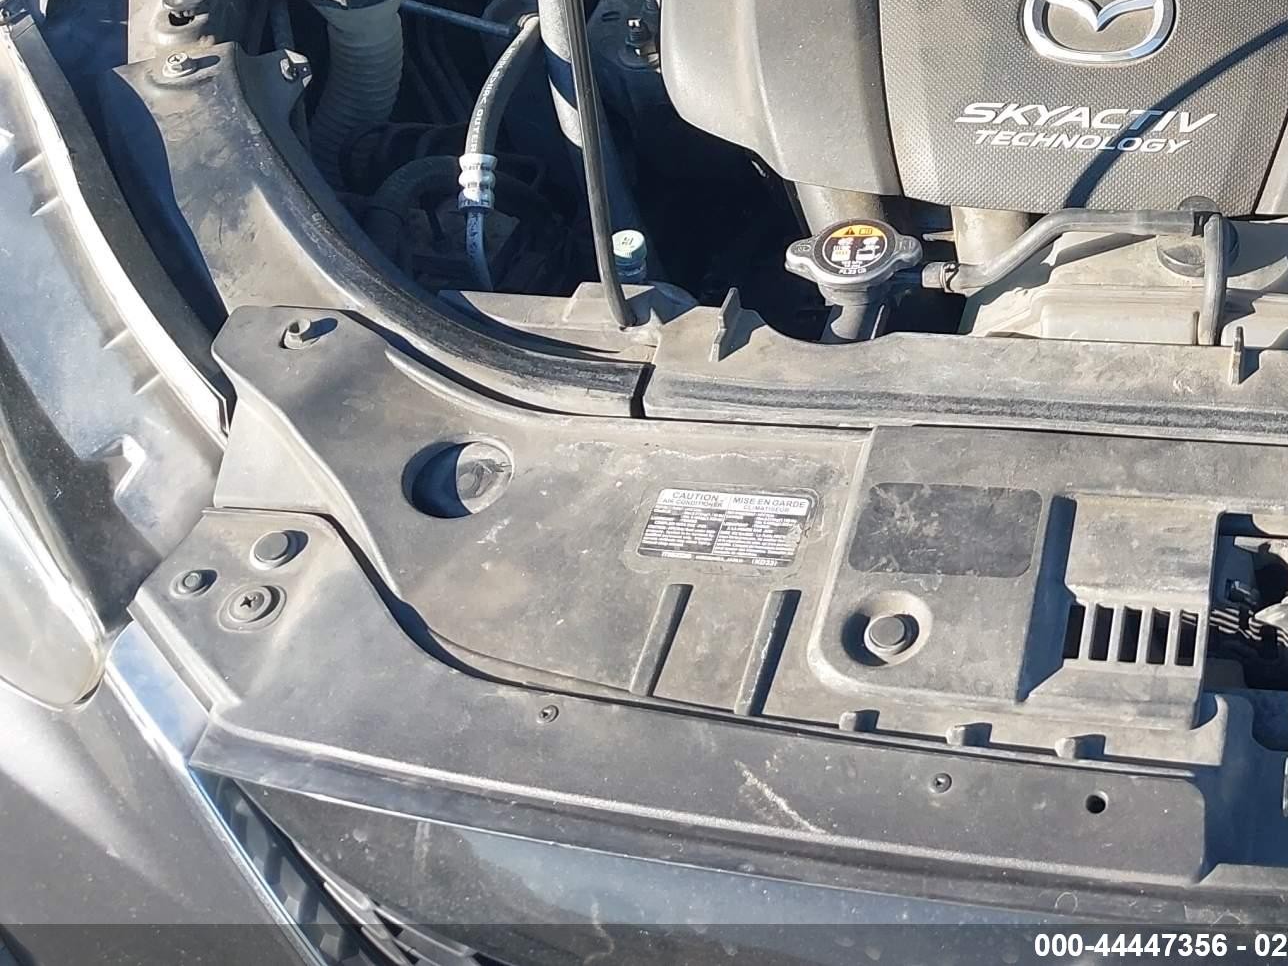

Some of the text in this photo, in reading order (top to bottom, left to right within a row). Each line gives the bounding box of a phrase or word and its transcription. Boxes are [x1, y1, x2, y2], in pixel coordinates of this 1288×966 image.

[954, 102, 1218, 133] SKYACTIV
[975, 130, 1192, 153] TECHNOLOGY
[672, 491, 719, 502] CAUTION
[676, 499, 723, 508] CONDITIONER
[733, 497, 806, 508] MISE EN GARDE
